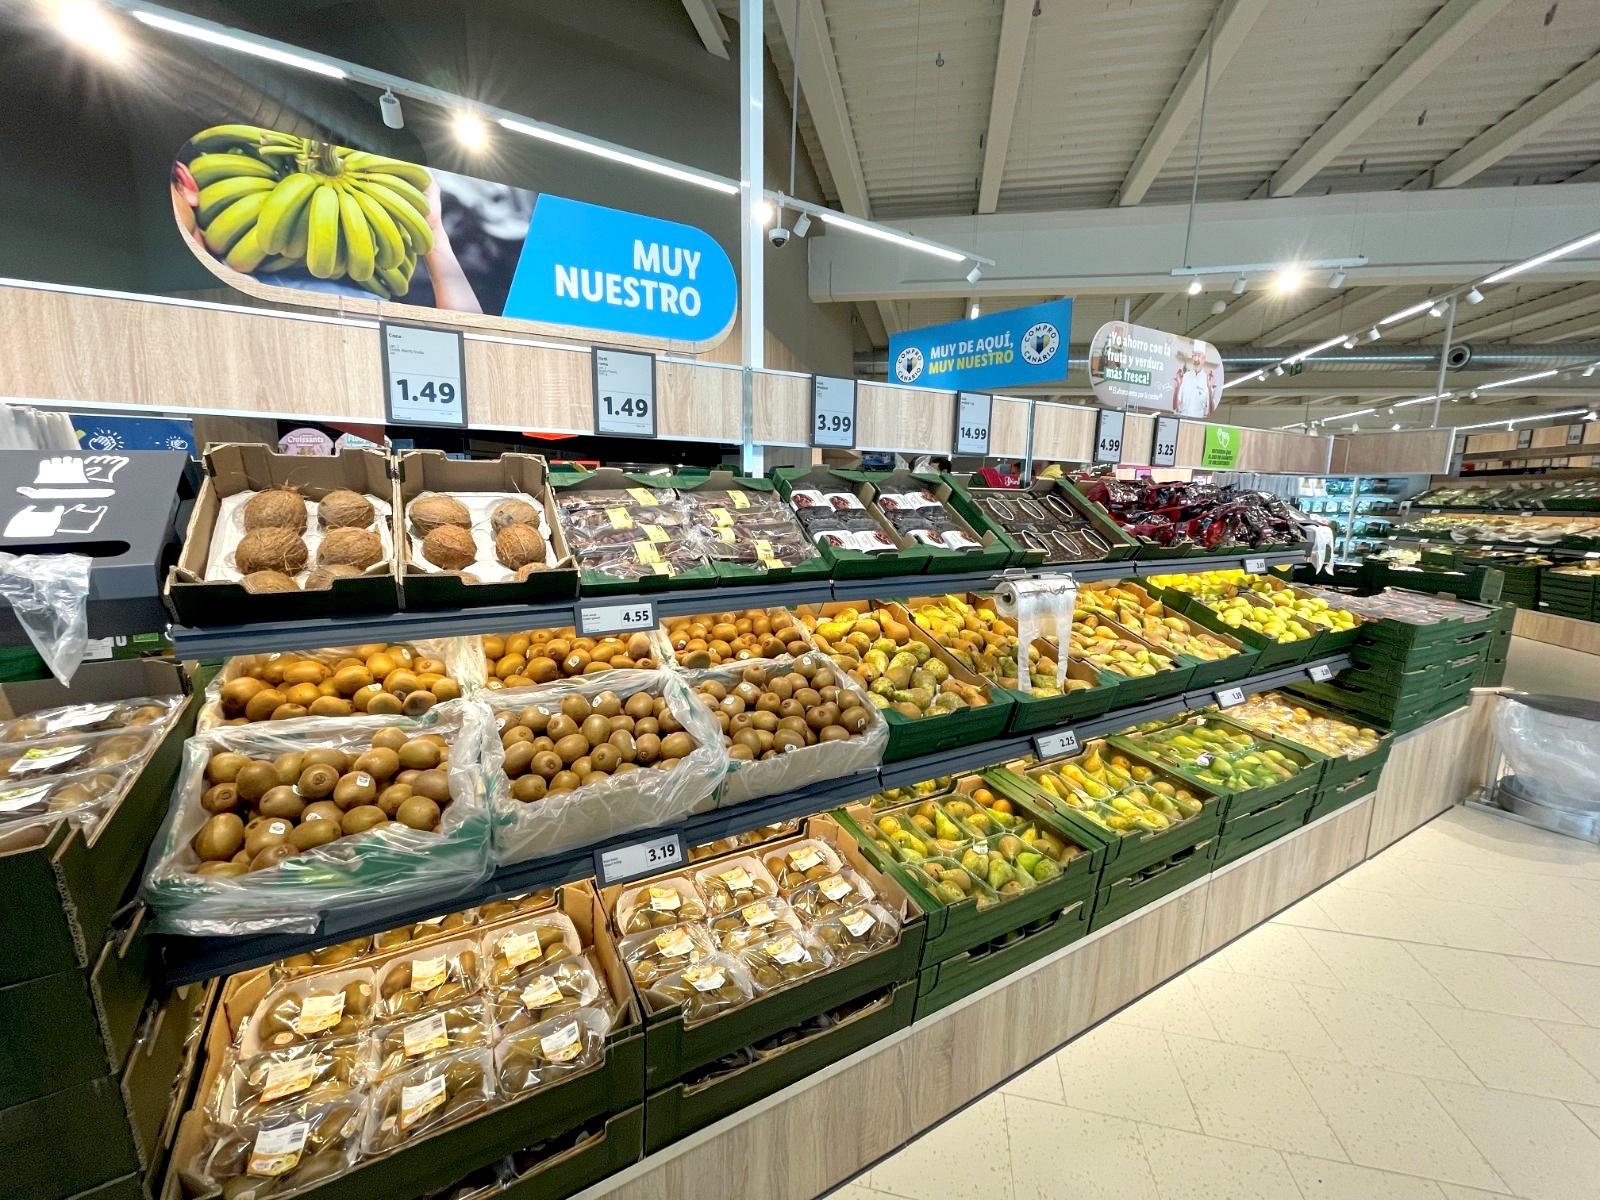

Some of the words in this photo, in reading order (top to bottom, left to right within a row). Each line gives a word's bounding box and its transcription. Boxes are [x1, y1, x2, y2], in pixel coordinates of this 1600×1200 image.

[633, 239, 701, 280] MUY
[555, 263, 701, 317] NUESTRO
[930, 343, 956, 360] MUY
[959, 340, 974, 355] DE
[976, 330, 1014, 353] AQUÍ,
[1108, 331, 1121, 346] ¡Yo
[1123, 334, 1148, 352] ahorro
[1149, 343, 1163, 355] con
[1164, 343, 1171, 357] la
[928, 359, 954, 375] MUY
[956, 349, 1014, 371] NUESTRO
[1107, 347, 1127, 364] fruta
[1129, 355, 1134, 368] y
[1135, 356, 1164, 371] verdura
[1106, 366, 1122, 380] más
[1124, 367, 1150, 385] fresca!
[396, 379, 455, 404] 1.49
[603, 396, 648, 418] 1.49
[817, 414, 851, 432] 3.99
[287, 435, 324, 444] Croissants
[960, 427, 987, 440] 14.99
[1100, 438, 1120, 452] 4.99
[1157, 443, 1174, 456] 3.25
[623, 610, 649, 622] 4.55
[1060, 736, 1075, 748] 2.25
[648, 843, 675, 862] 3.19
